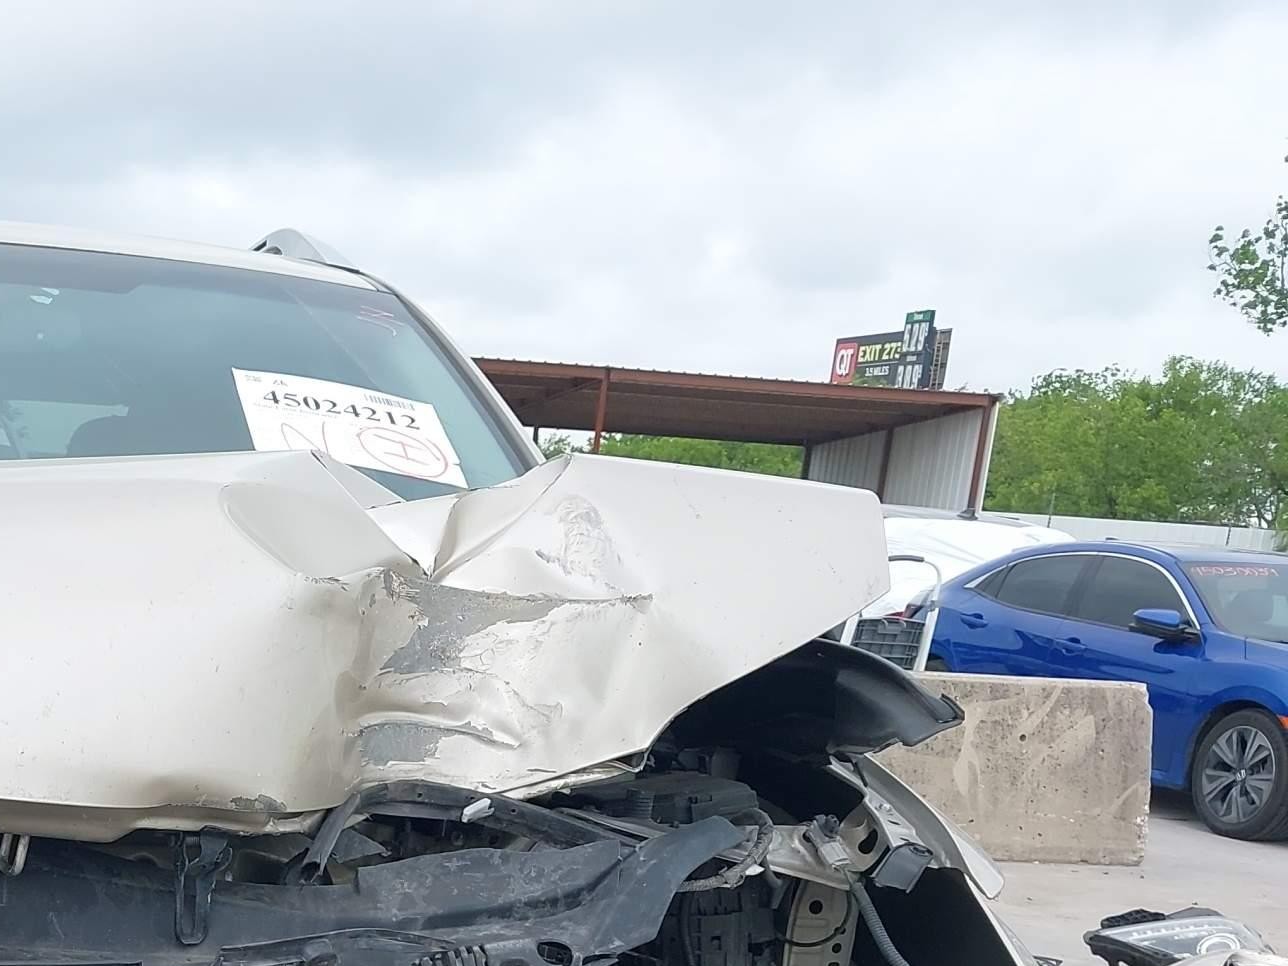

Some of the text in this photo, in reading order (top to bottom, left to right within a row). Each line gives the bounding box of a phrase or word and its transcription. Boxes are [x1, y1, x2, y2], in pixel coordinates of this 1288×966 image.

[835, 348, 854, 376] QT
[857, 344, 882, 362] EXIT
[263, 389, 420, 431] 45024212
